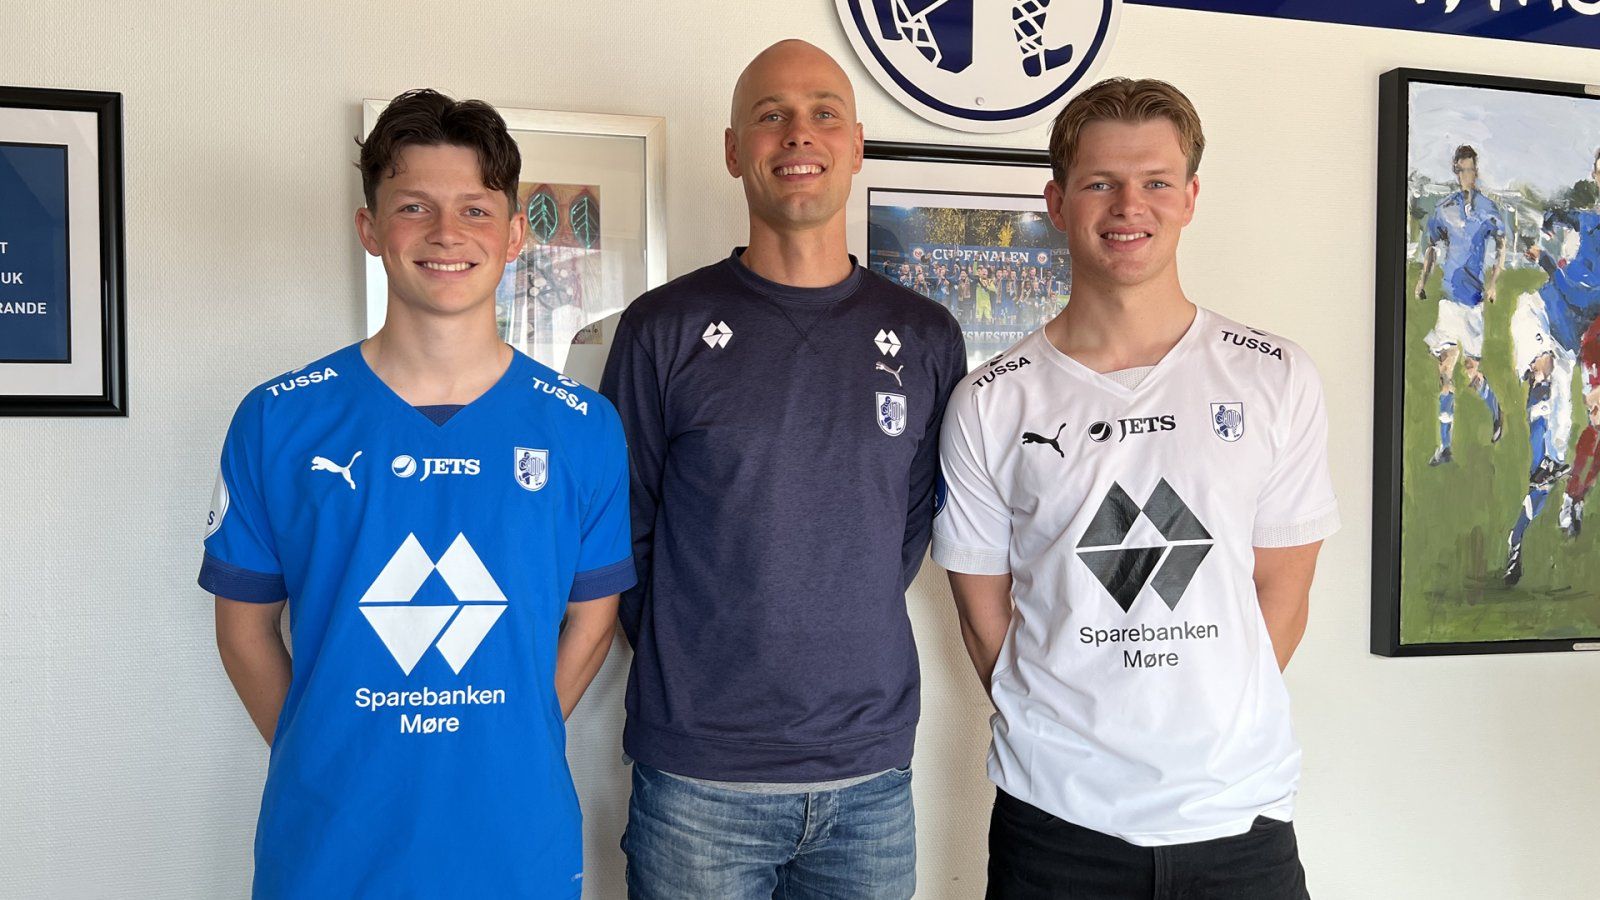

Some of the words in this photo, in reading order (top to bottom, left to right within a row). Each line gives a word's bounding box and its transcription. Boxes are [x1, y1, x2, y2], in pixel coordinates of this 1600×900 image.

[961, 331, 1025, 344] SMESTER
[1221, 330, 1283, 361] TUSSA
[265, 367, 339, 397] TUSSA
[971, 356, 1032, 388] TUSSA
[532, 376, 588, 417] TUSSA
[1117, 414, 1177, 443] JETS
[419, 458, 481, 482] JETS
[1079, 621, 1220, 648] Sparebanken
[1123, 649, 1180, 669] Møre
[354, 684, 506, 712] Sparebanken
[400, 713, 460, 734] Møre
